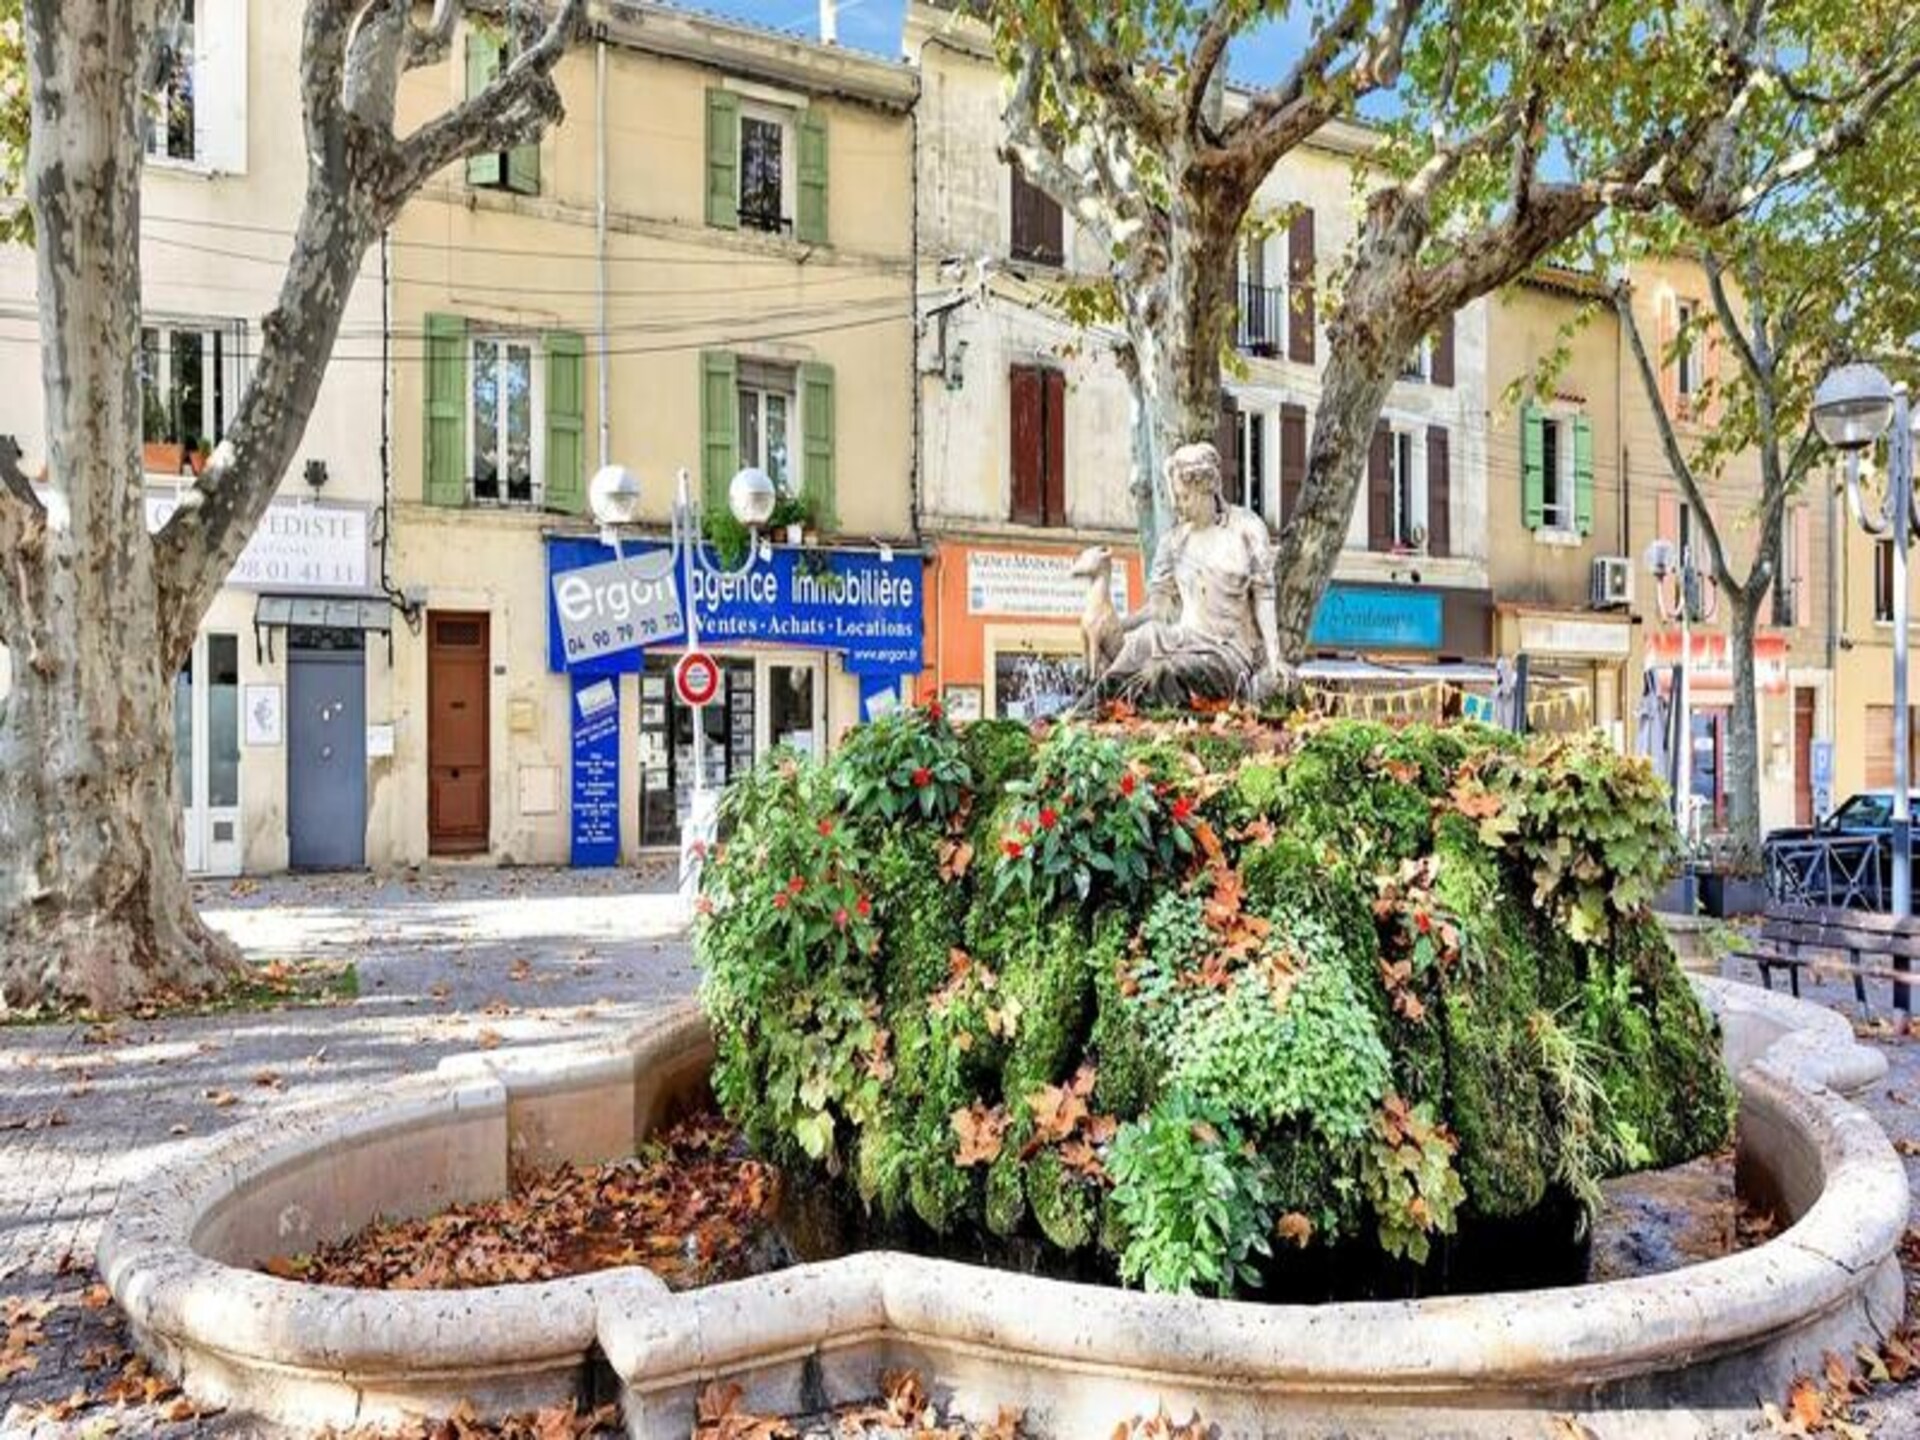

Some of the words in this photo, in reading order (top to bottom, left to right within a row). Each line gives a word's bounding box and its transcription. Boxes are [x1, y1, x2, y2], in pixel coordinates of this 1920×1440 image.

[263, 512, 354, 539] EDISTE
[559, 574, 676, 621] ergon
[692, 568, 778, 612] agence
[792, 566, 913, 606] immobilière
[568, 636, 585, 655] 04
[592, 629, 610, 649] 90
[616, 623, 634, 642] 79
[695, 614, 757, 635] Ventes
[767, 615, 825, 635] Achats
[836, 618, 913, 637] Locations
